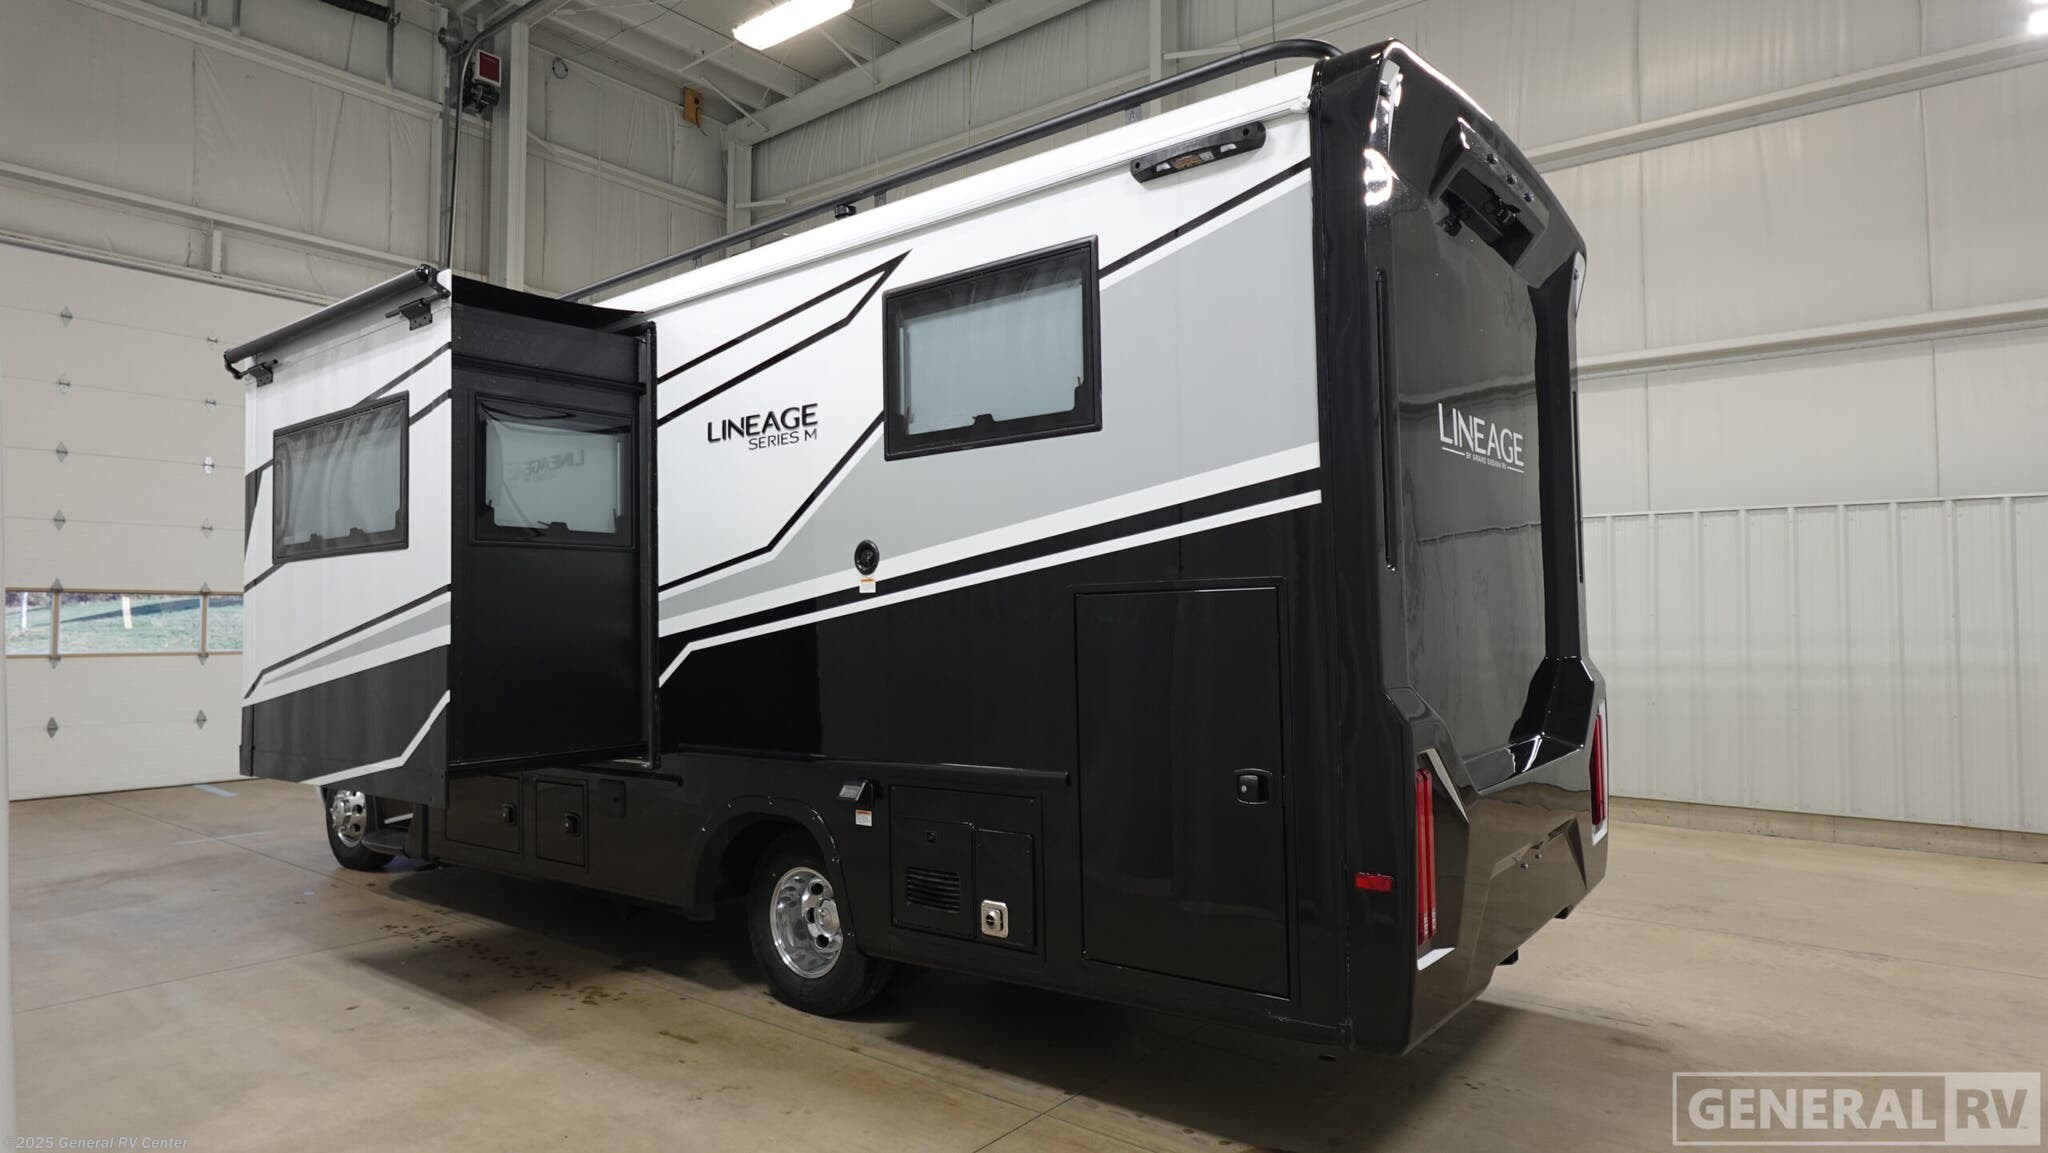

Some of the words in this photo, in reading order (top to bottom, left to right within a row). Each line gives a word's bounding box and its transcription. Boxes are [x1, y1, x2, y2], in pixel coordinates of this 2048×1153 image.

[707, 403, 818, 443] LINEAGE
[748, 431, 800, 450] SERIES
[804, 428, 817, 441] M
[1438, 402, 1524, 467] LINEAGE
